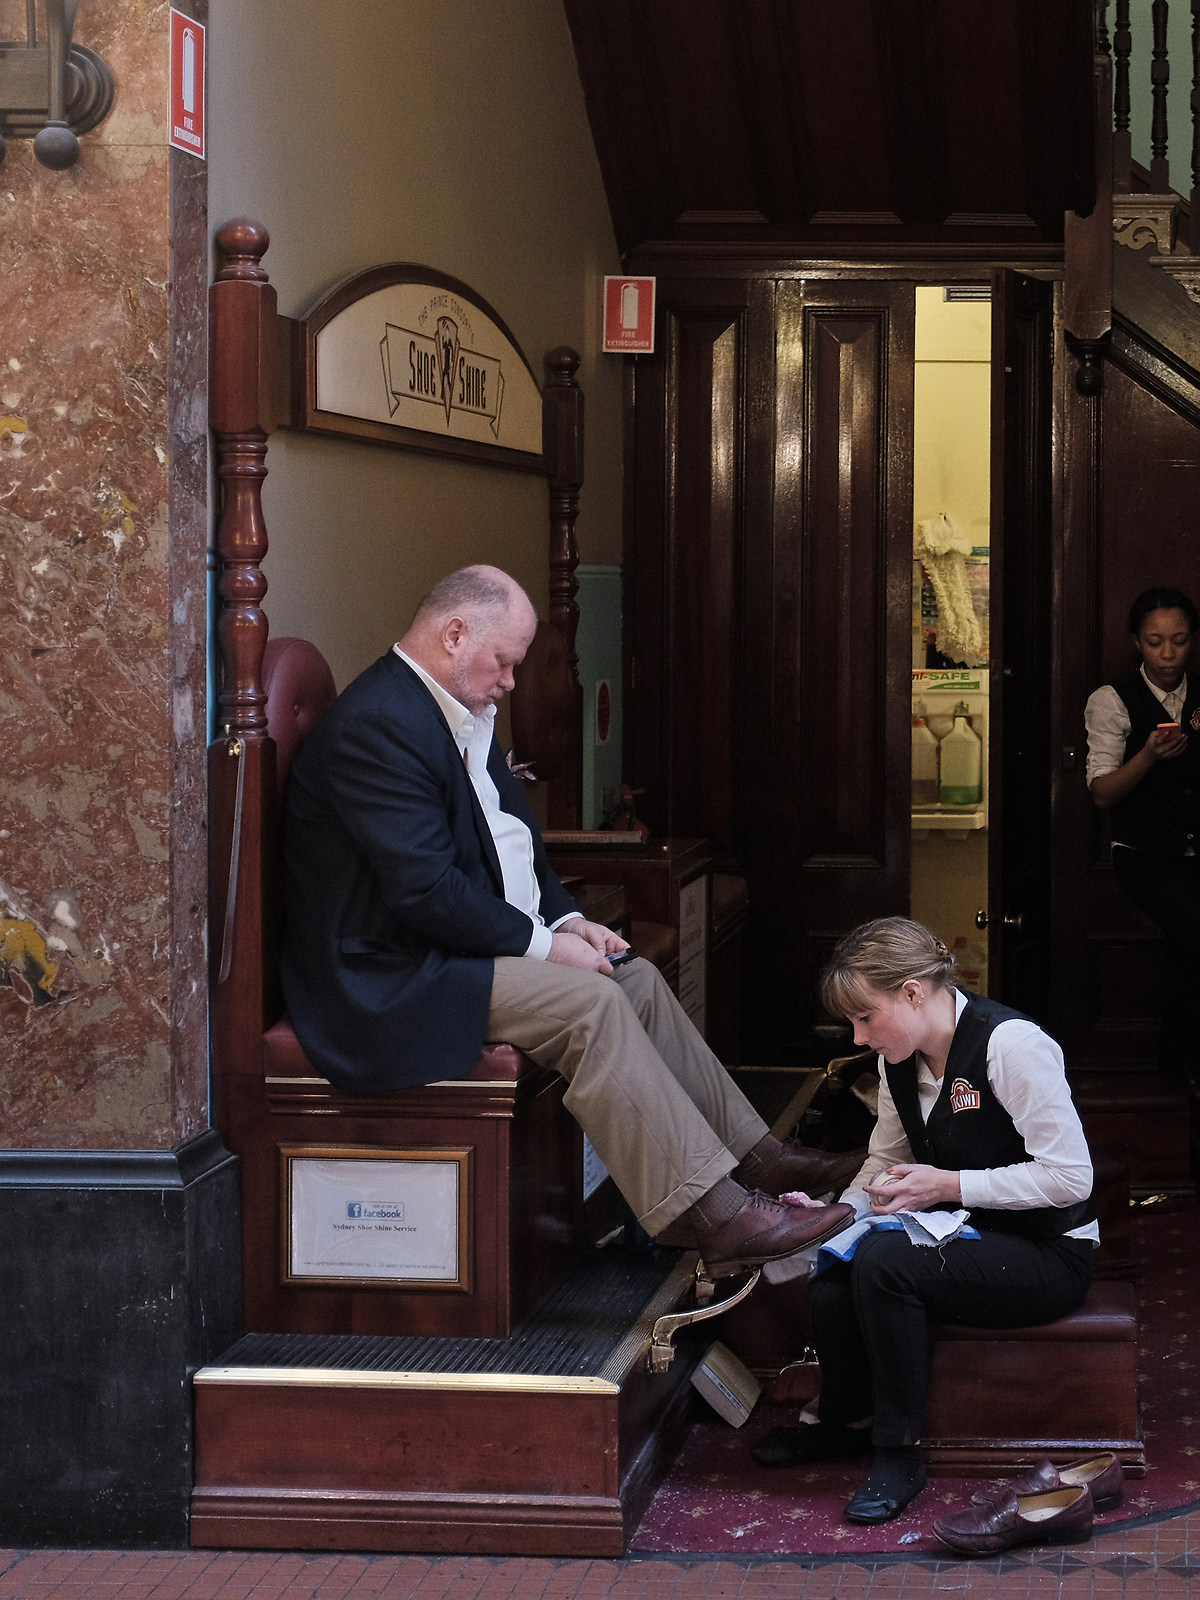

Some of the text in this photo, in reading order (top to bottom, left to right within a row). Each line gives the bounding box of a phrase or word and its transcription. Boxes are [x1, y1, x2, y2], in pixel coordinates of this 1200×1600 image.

[183, 116, 194, 131] FIRE
[409, 340, 487, 409] SHOE SHINE
[953, 1094, 976, 1109] KIWI
[364, 1208, 401, 1218] facebook
